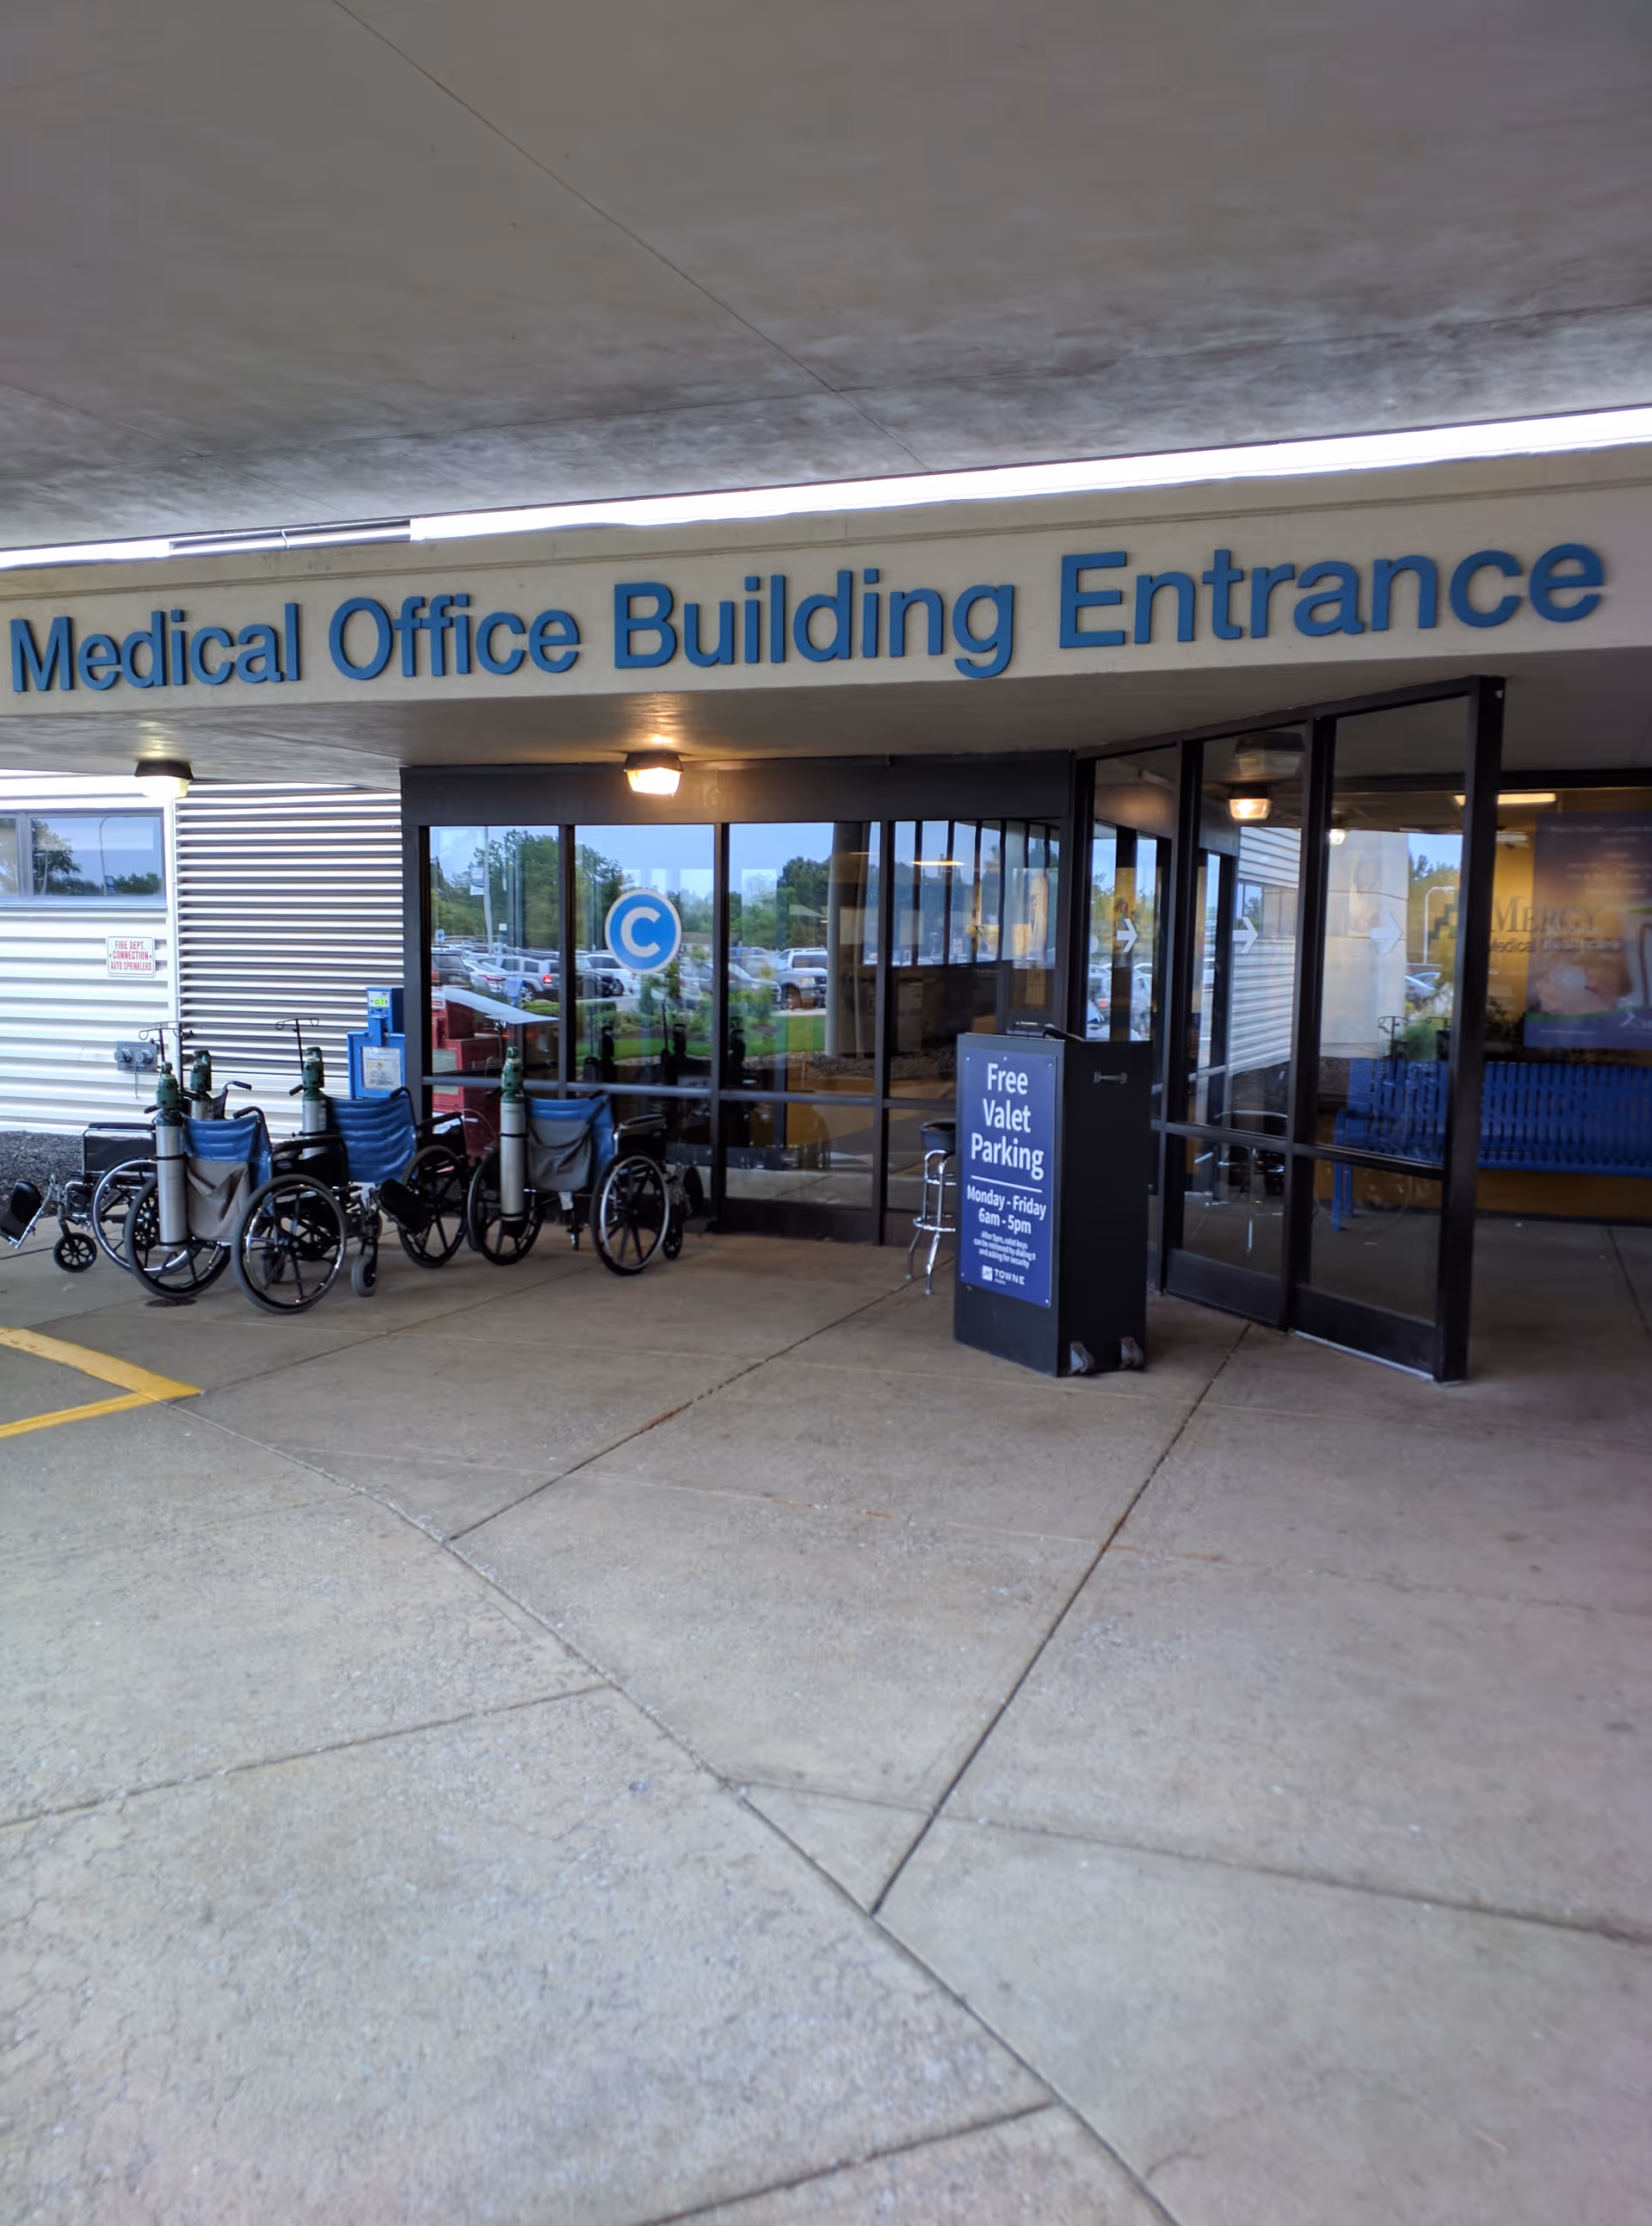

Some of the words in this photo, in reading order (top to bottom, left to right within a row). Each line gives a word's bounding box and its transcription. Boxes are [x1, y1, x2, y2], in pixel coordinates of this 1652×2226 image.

[9, 601, 301, 693] Medical
[328, 592, 582, 681] Office
[613, 568, 1014, 679] Building
[1058, 544, 1606, 648] Entrance
[114, 940, 127, 950] FIRE
[130, 940, 145, 950] DEPT.
[620, 906, 662, 958] C
[110, 961, 123, 971] AUTO
[123, 961, 152, 971] SPRINKLERS
[113, 950, 149, 960] CONNECTION
[987, 1063, 1028, 1095] Free
[983, 1098, 1032, 1133] Valet
[971, 1132, 1045, 1181] Parking
[966, 1184, 1005, 1212] Monday
[1013, 1195, 1046, 1221] Friday
[978, 1207, 1001, 1227] 6am
[1008, 1214, 1032, 1235] 5pm
[994, 1268, 1026, 1286] TOWNE
